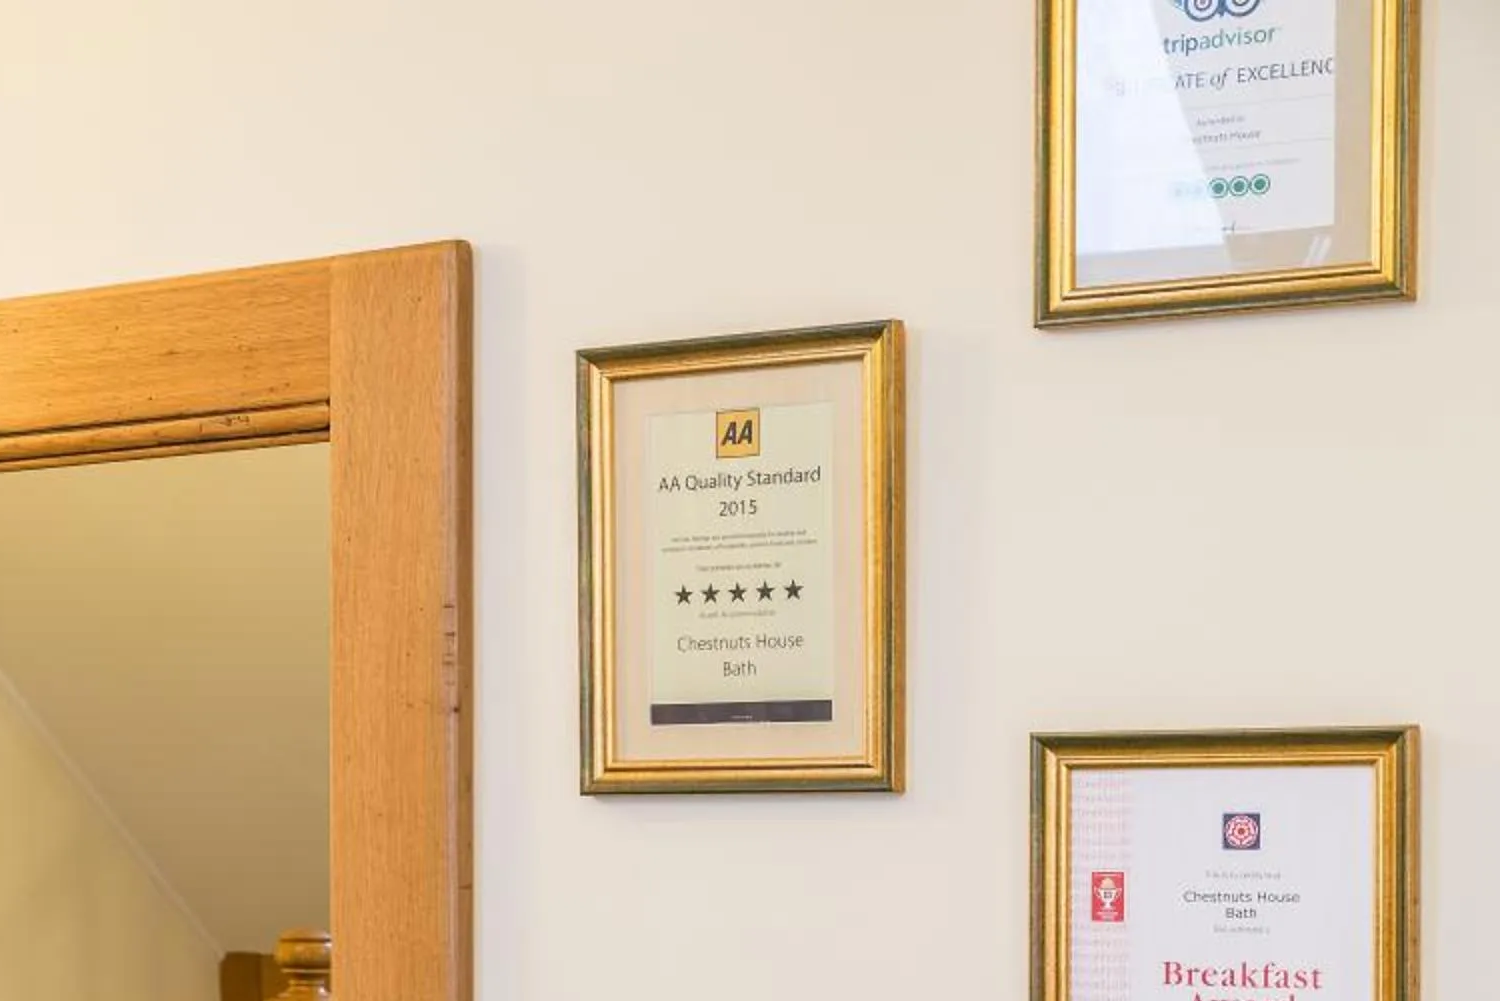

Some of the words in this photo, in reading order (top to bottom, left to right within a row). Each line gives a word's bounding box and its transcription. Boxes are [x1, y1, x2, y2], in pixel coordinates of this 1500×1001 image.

[1163, 26, 1277, 56] tripadvisor
[720, 419, 754, 447] AA
[658, 477, 681, 492] AA
[685, 473, 743, 492] Quality
[747, 465, 822, 487] Standard
[718, 499, 758, 518] 2015
[677, 635, 751, 653] Chestnuts
[756, 633, 804, 649] House
[723, 660, 757, 678] Bath
[1182, 890, 1253, 904] Chestnuts
[1257, 891, 1301, 904] House
[1225, 907, 1257, 919] Bath
[1163, 960, 1323, 990] Breakfast
